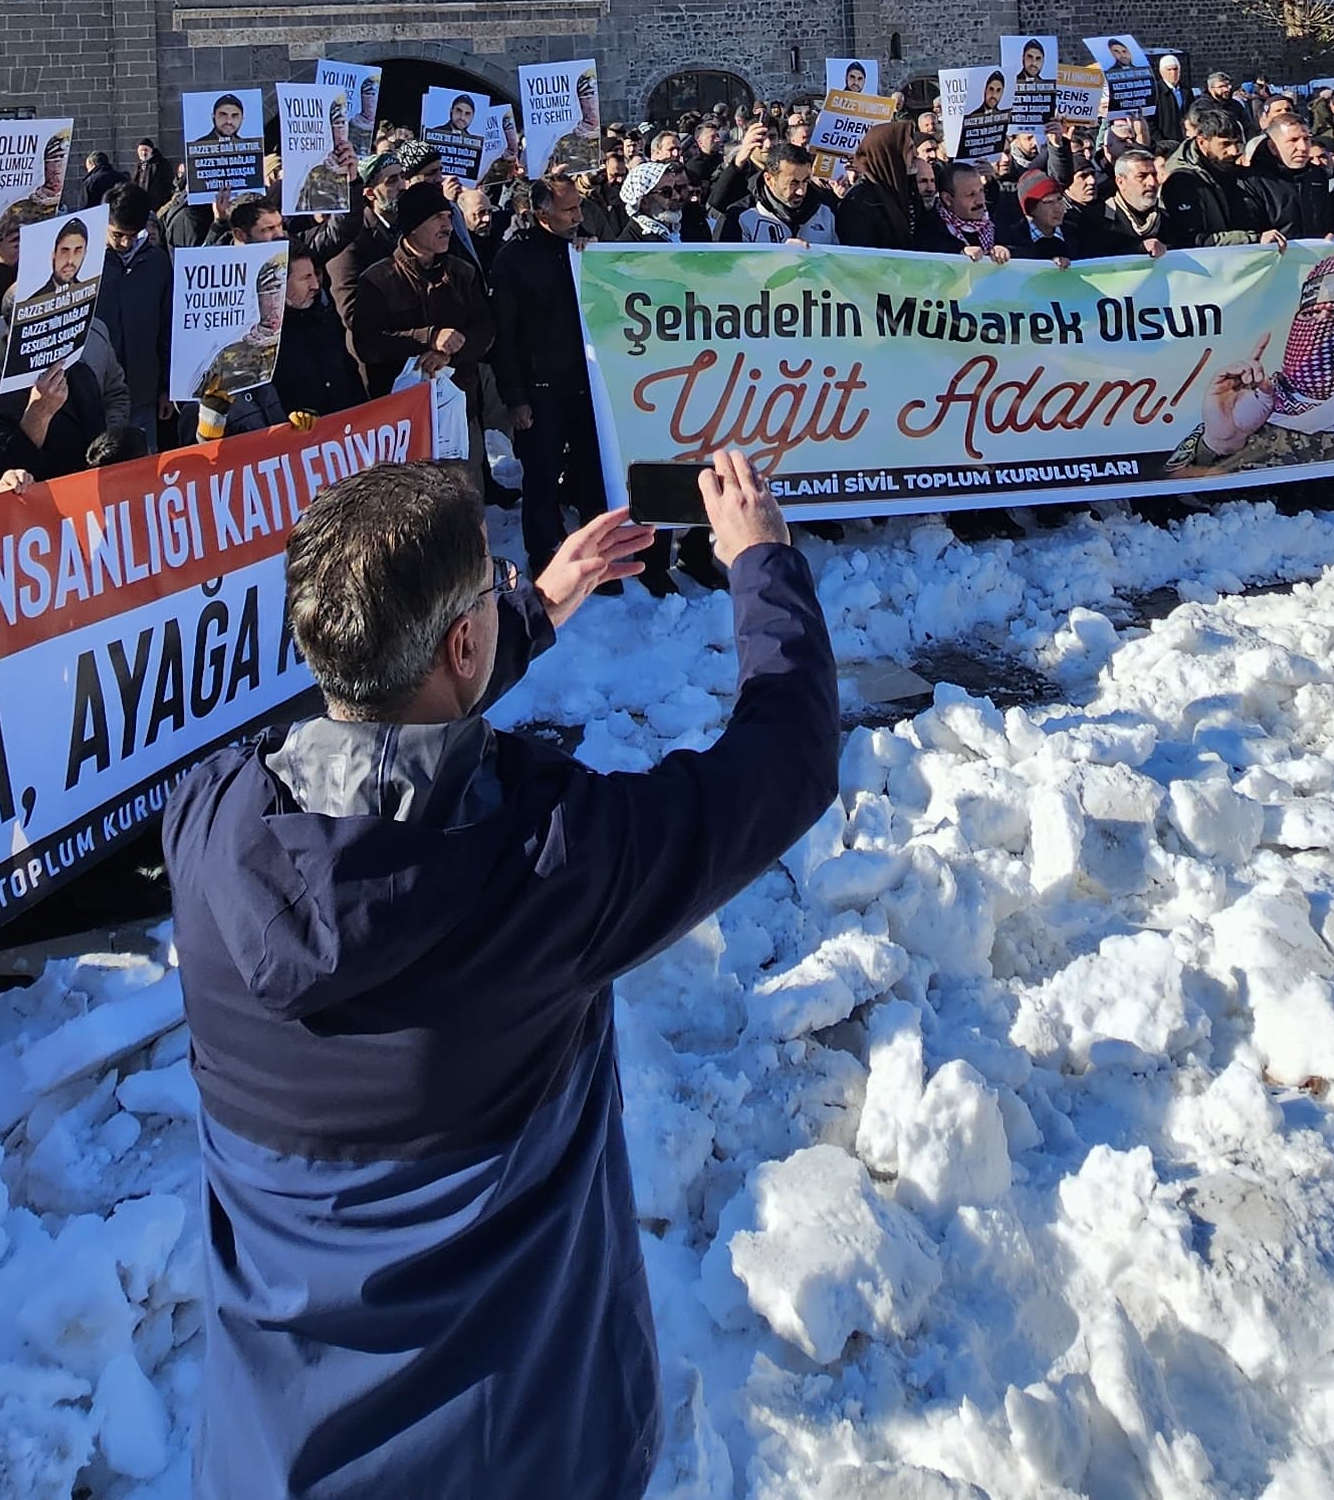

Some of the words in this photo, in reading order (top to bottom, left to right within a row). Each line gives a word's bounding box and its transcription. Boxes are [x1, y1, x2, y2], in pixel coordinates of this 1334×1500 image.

[526, 75, 570, 97] YOLUN
[529, 94, 571, 111] YOLUMUZ
[1057, 89, 1090, 106] RENİŞ
[284, 98, 324, 119] YOLUN
[1058, 103, 1093, 117] ÜYOR!
[287, 120, 324, 134] YOLUMUZ
[531, 113, 543, 125] EY
[544, 111, 572, 126] ŞEHİT!
[834, 117, 874, 134] DİREN
[288, 137, 299, 151] EY
[300, 136, 325, 154] ŞEHİT!
[0, 172, 33, 190] ŞEHİT!
[184, 262, 247, 290] YOLUN
[185, 290, 245, 309] YOLUMUZ
[184, 312, 200, 329] EY
[204, 307, 245, 331] ŞEHİT!
[623, 289, 863, 356] Şehadetin
[875, 292, 1084, 345] Mübarek
[1097, 296, 1223, 343] Olsun
[633, 348, 870, 476] Yiğit
[896, 347, 1212, 460] Adam!
[844, 470, 900, 494] SİVİL
[903, 467, 991, 490] TOPLUM
[994, 459, 1139, 486] KURULUŞLARI
[65, 580, 260, 791] AYAĞA
